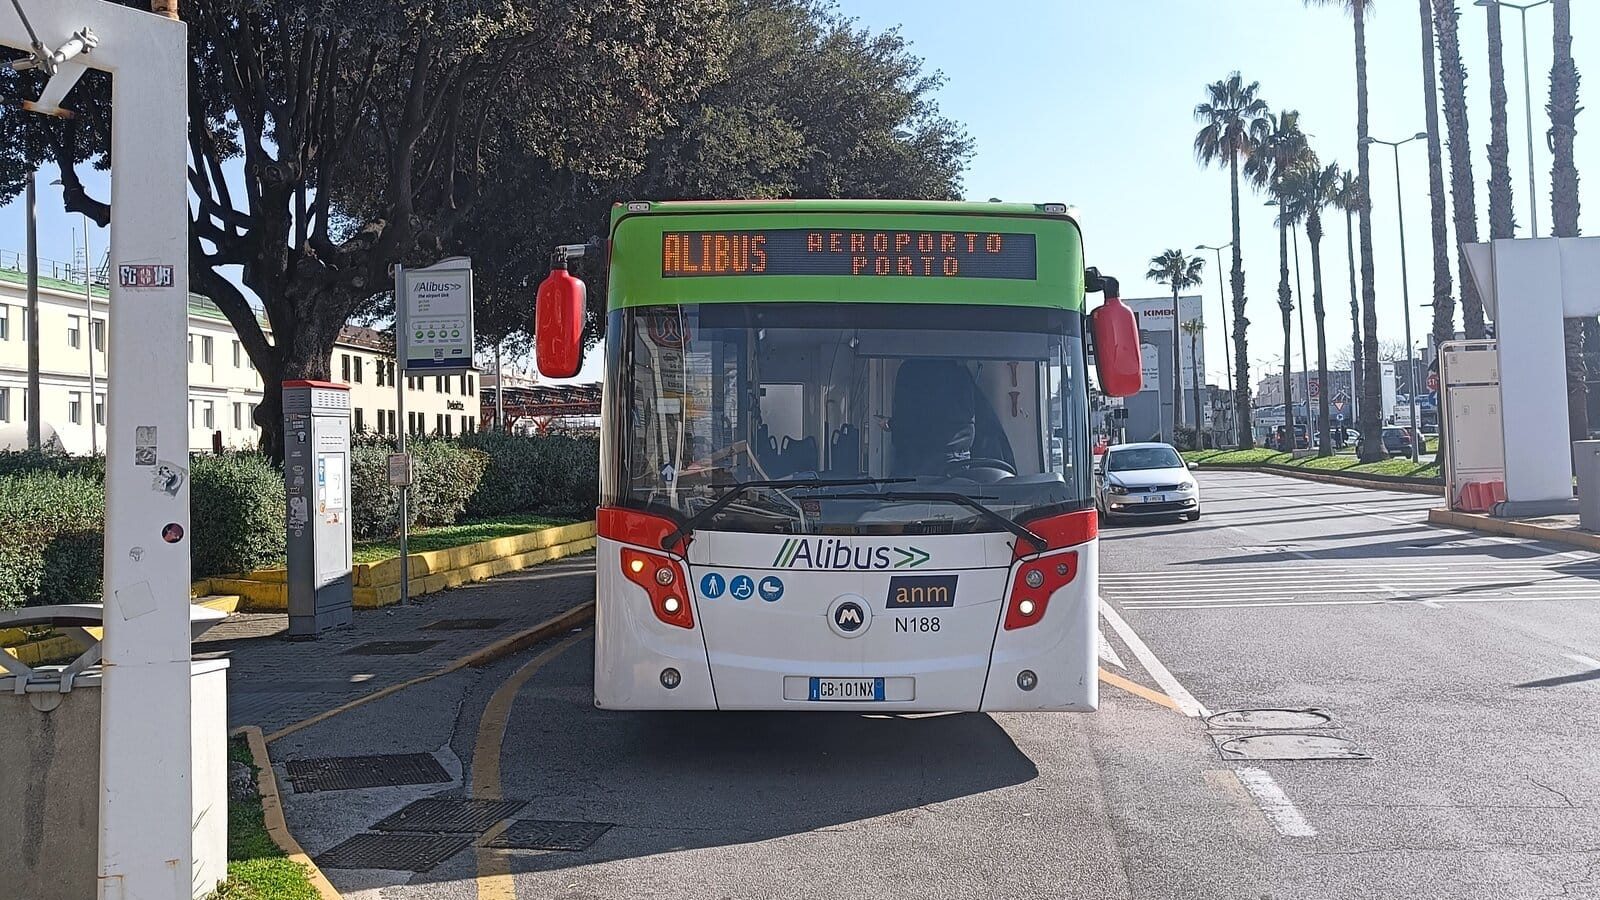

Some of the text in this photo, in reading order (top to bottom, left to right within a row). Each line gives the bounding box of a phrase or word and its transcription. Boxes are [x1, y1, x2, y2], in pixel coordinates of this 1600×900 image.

[664, 232, 1002, 273] ALIBUS AEROPORTO
[852, 255, 960, 276] PORTO
[419, 281, 450, 292] Alibus
[788, 538, 890, 570] Alibus
[896, 583, 948, 603] anm
[895, 616, 941, 633] N188
